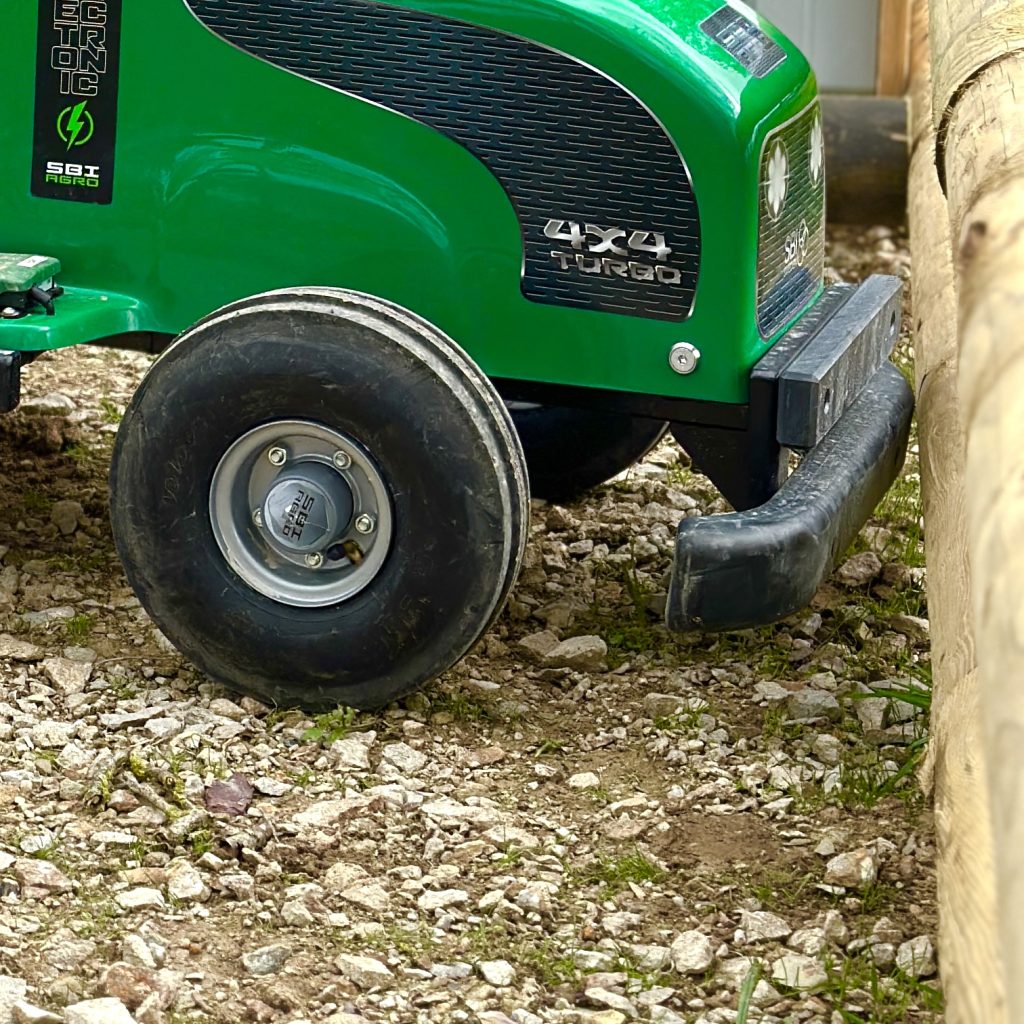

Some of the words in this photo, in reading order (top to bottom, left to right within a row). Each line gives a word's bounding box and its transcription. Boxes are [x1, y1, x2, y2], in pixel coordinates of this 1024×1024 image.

[45, 161, 100, 178] SBI
[45, 174, 99, 187] AGRO
[550, 250, 682, 284] TURBO
[291, 494, 315, 541] SBI
